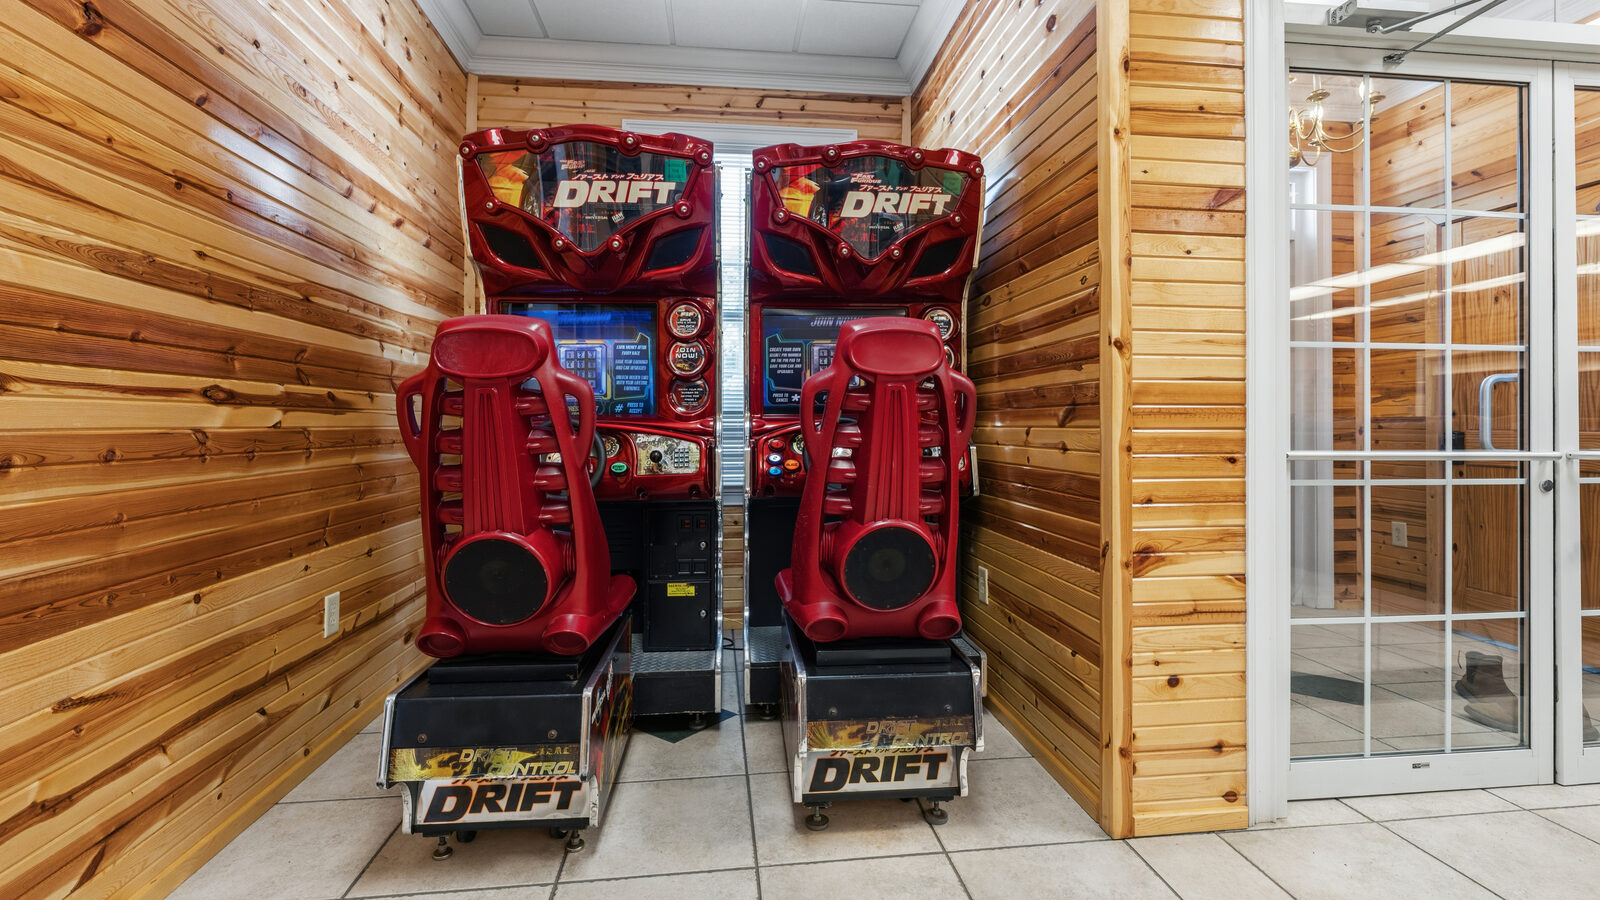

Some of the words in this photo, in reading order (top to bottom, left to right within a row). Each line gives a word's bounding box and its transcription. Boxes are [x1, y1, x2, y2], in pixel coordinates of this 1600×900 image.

[552, 180, 677, 208] DRIFT
[840, 190, 952, 218] DRIFT
[459, 747, 518, 763] DRIFT
[808, 753, 949, 793] DRIFT
[423, 781, 583, 823] DRIFT
